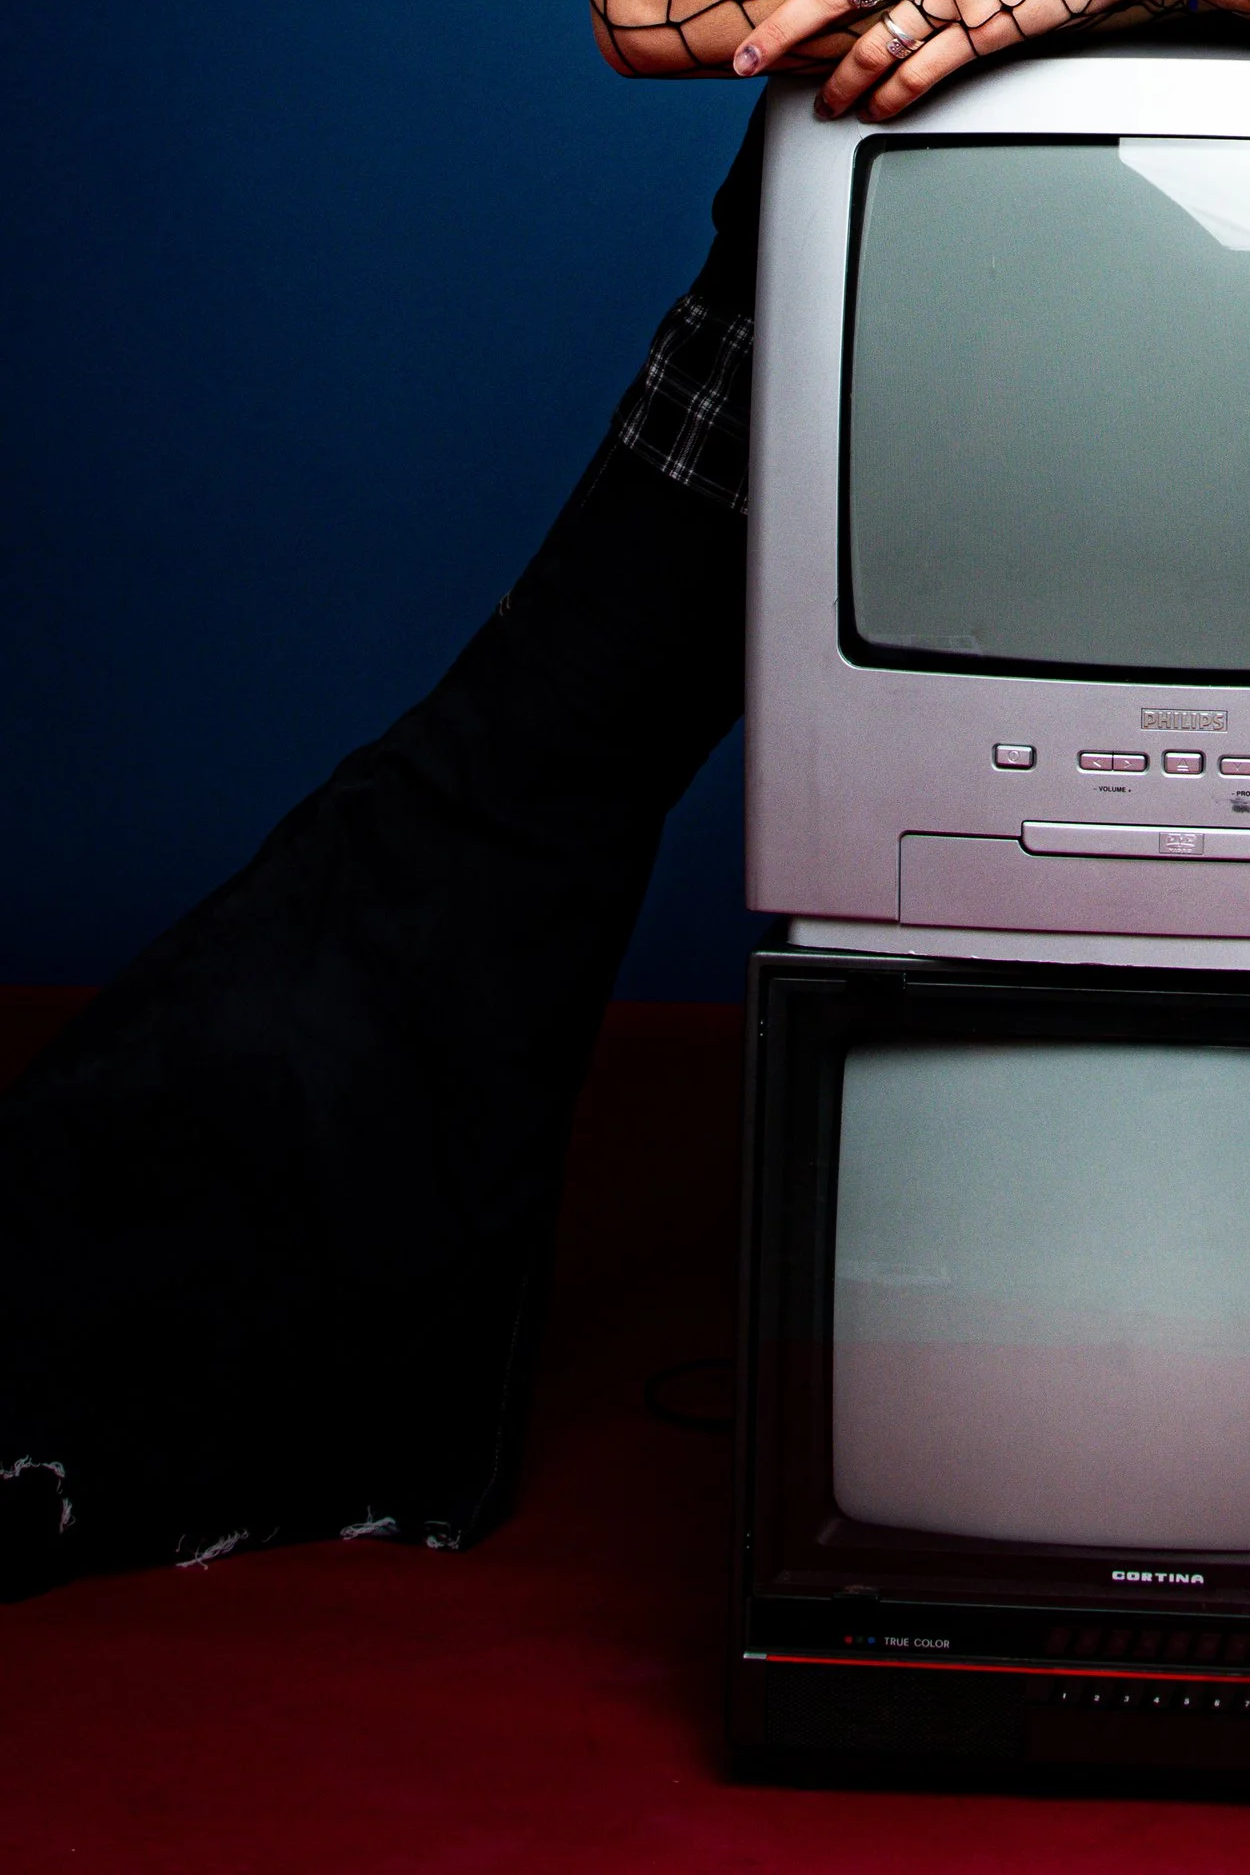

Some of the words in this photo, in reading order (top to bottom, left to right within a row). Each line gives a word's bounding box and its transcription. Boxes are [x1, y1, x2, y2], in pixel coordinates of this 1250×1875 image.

[1143, 710, 1225, 731] PHILIPS
[1111, 1571, 1205, 1584] CORTINA
[884, 1636, 909, 1647] TRUE
[913, 1638, 951, 1649] COLOR
